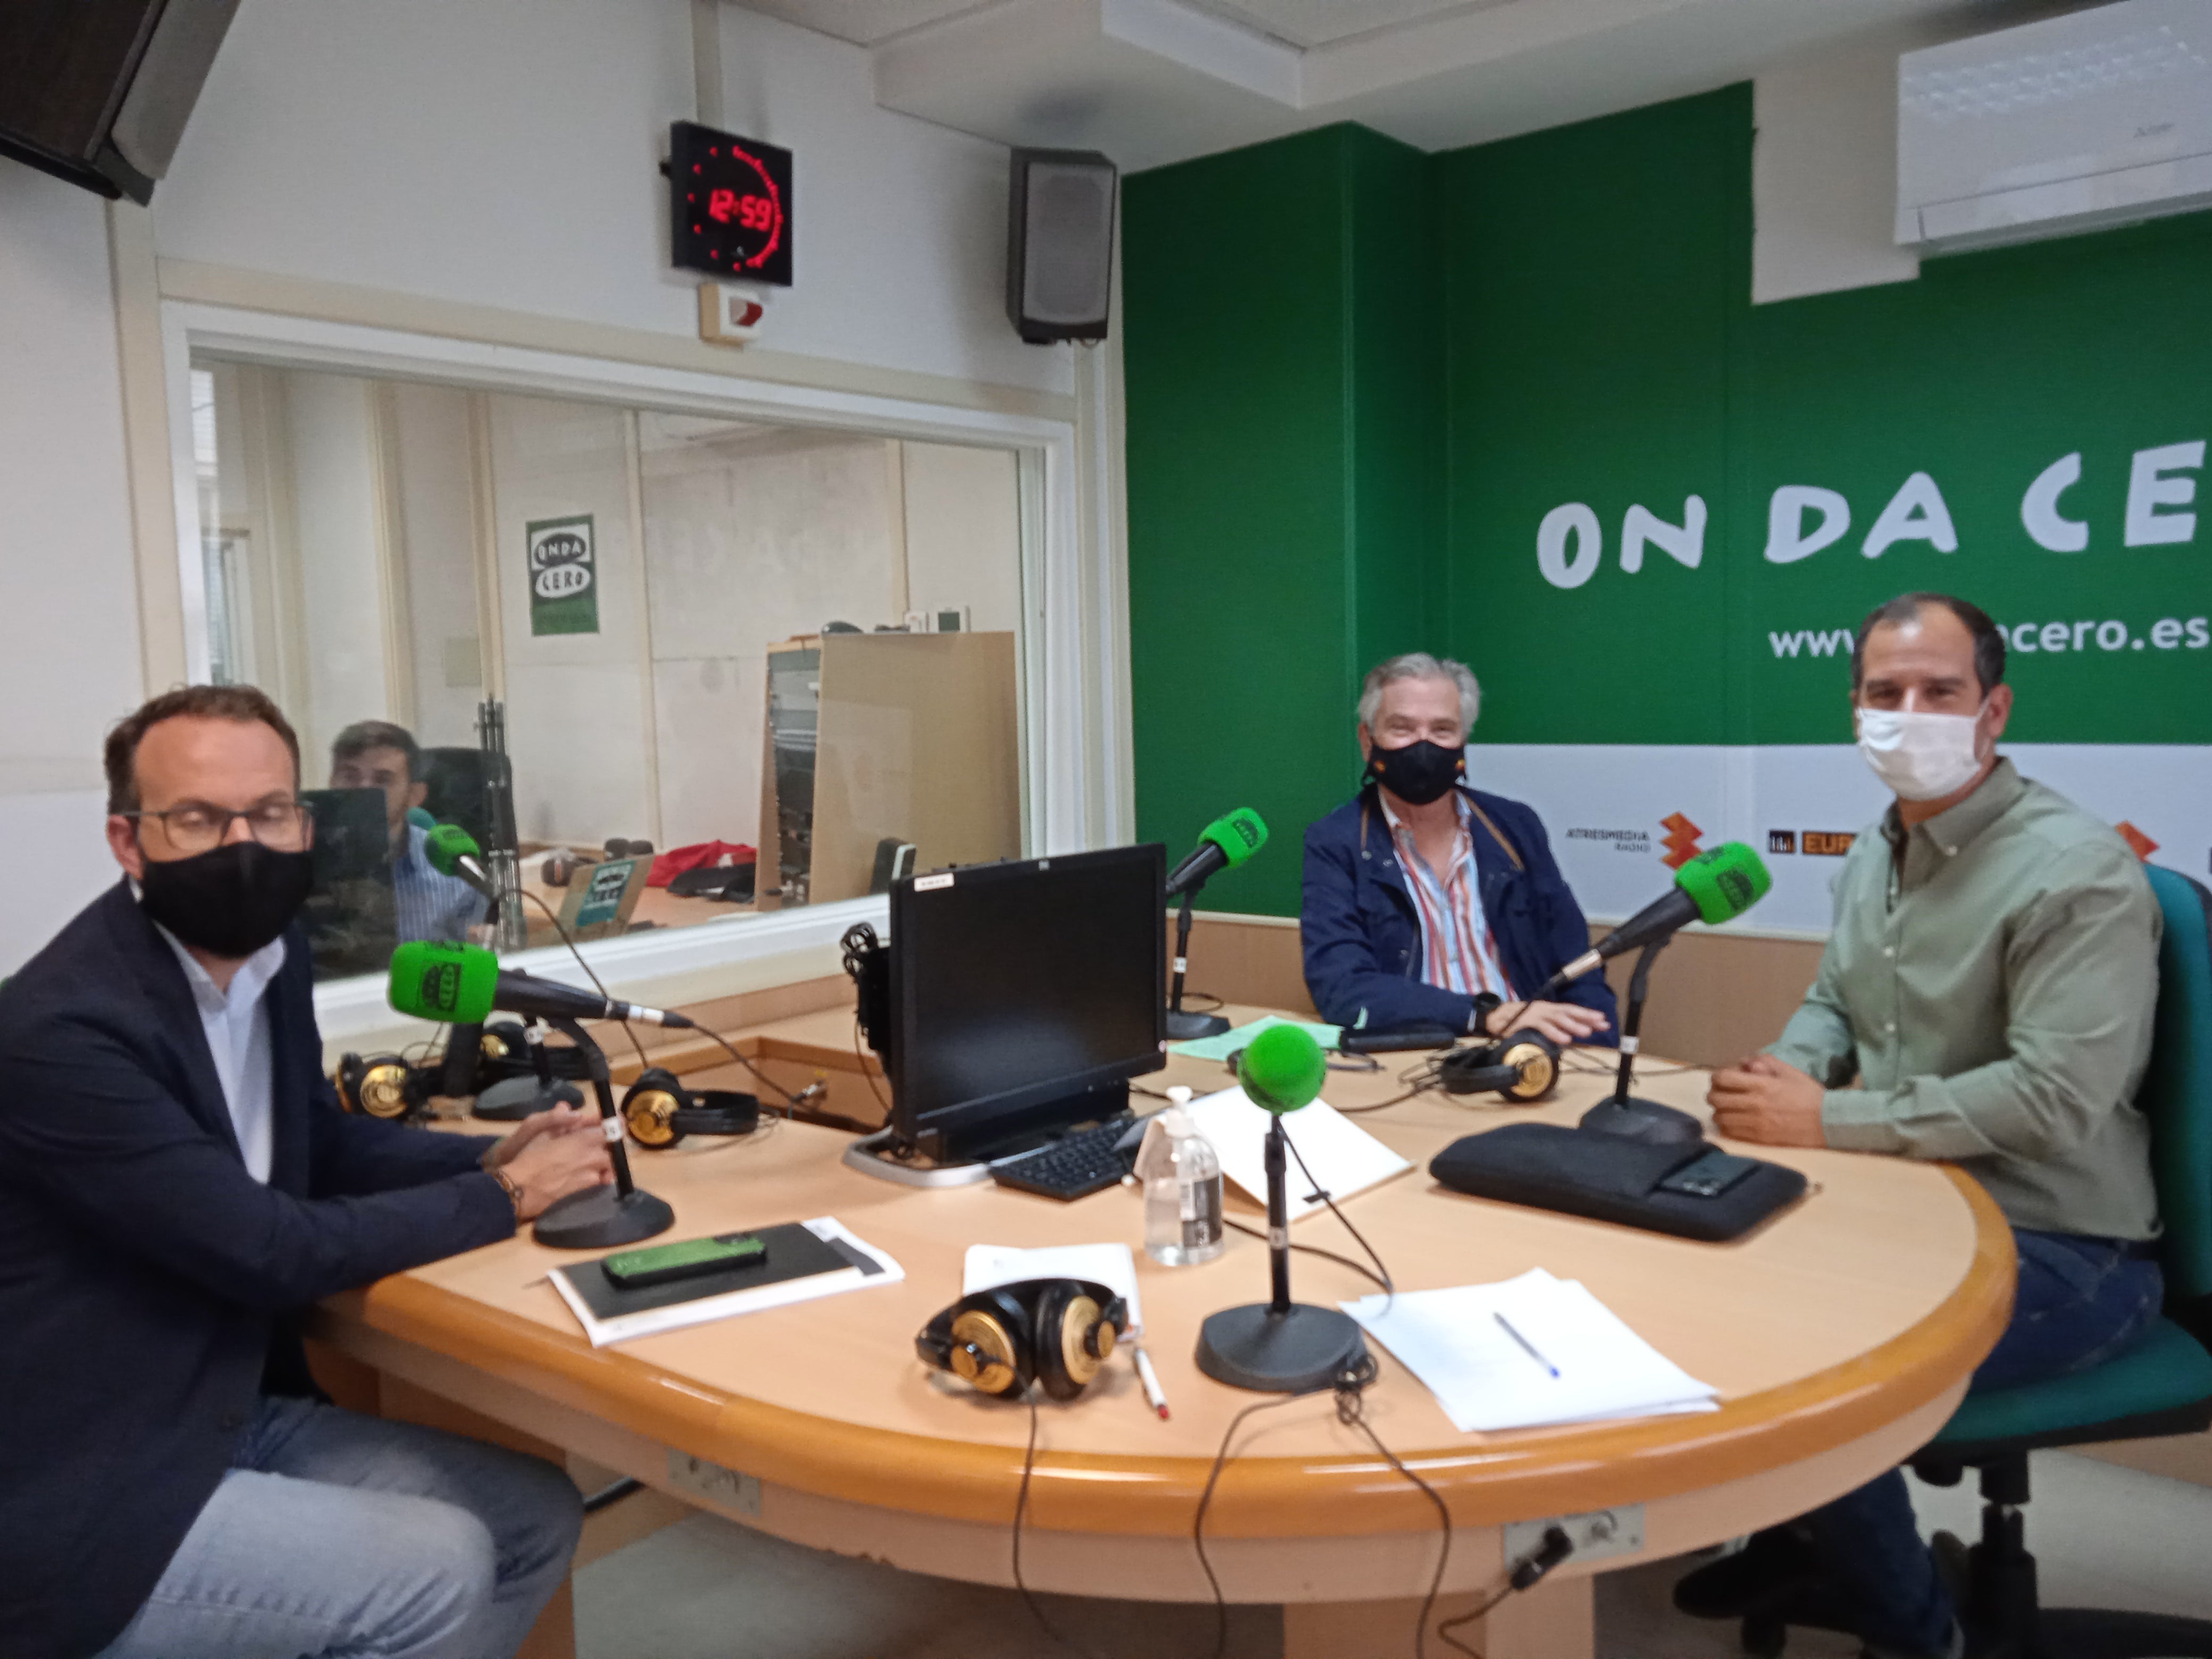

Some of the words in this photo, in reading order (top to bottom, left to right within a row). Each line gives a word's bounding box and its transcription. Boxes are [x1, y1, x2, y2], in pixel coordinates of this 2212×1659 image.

[709, 189, 772, 232] 12:59
[538, 541, 582, 560] ONDA
[542, 571, 583, 590] CERO
